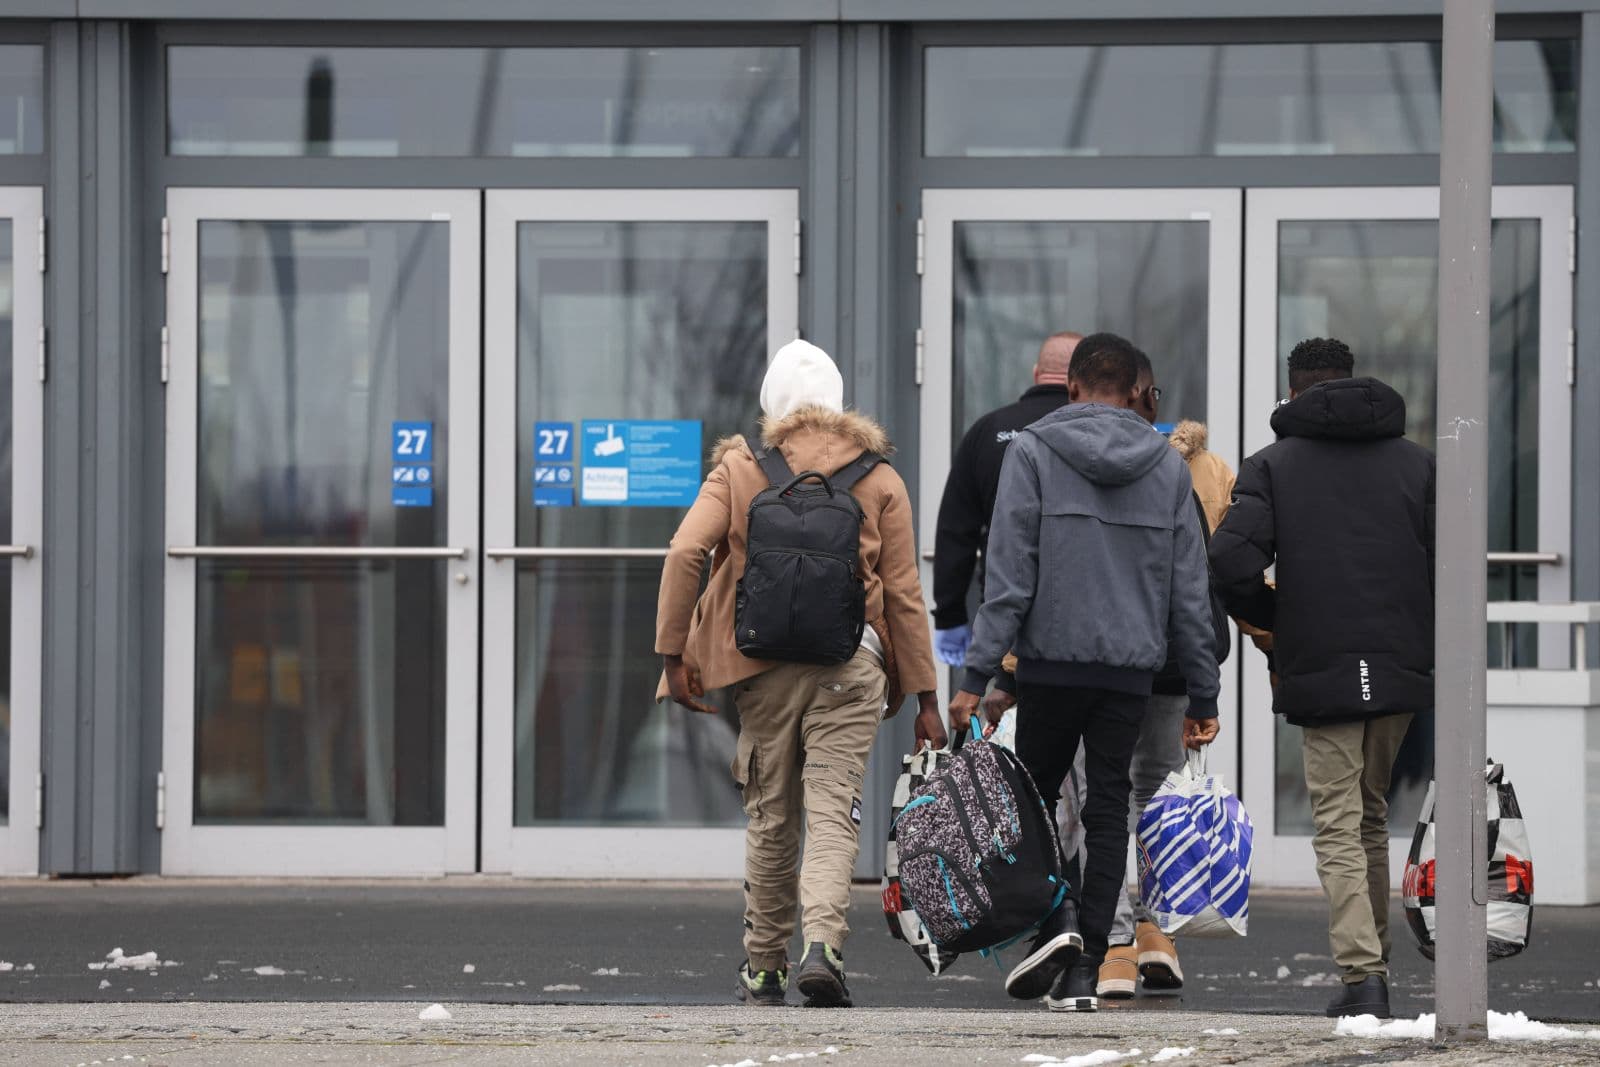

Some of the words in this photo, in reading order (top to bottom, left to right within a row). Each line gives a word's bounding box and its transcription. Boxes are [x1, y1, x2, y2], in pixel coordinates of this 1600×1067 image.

[397, 429, 427, 455] 27
[538, 429, 569, 455] 27
[585, 472, 625, 485] Achtung
[1359, 659, 1371, 701] CNTMP
